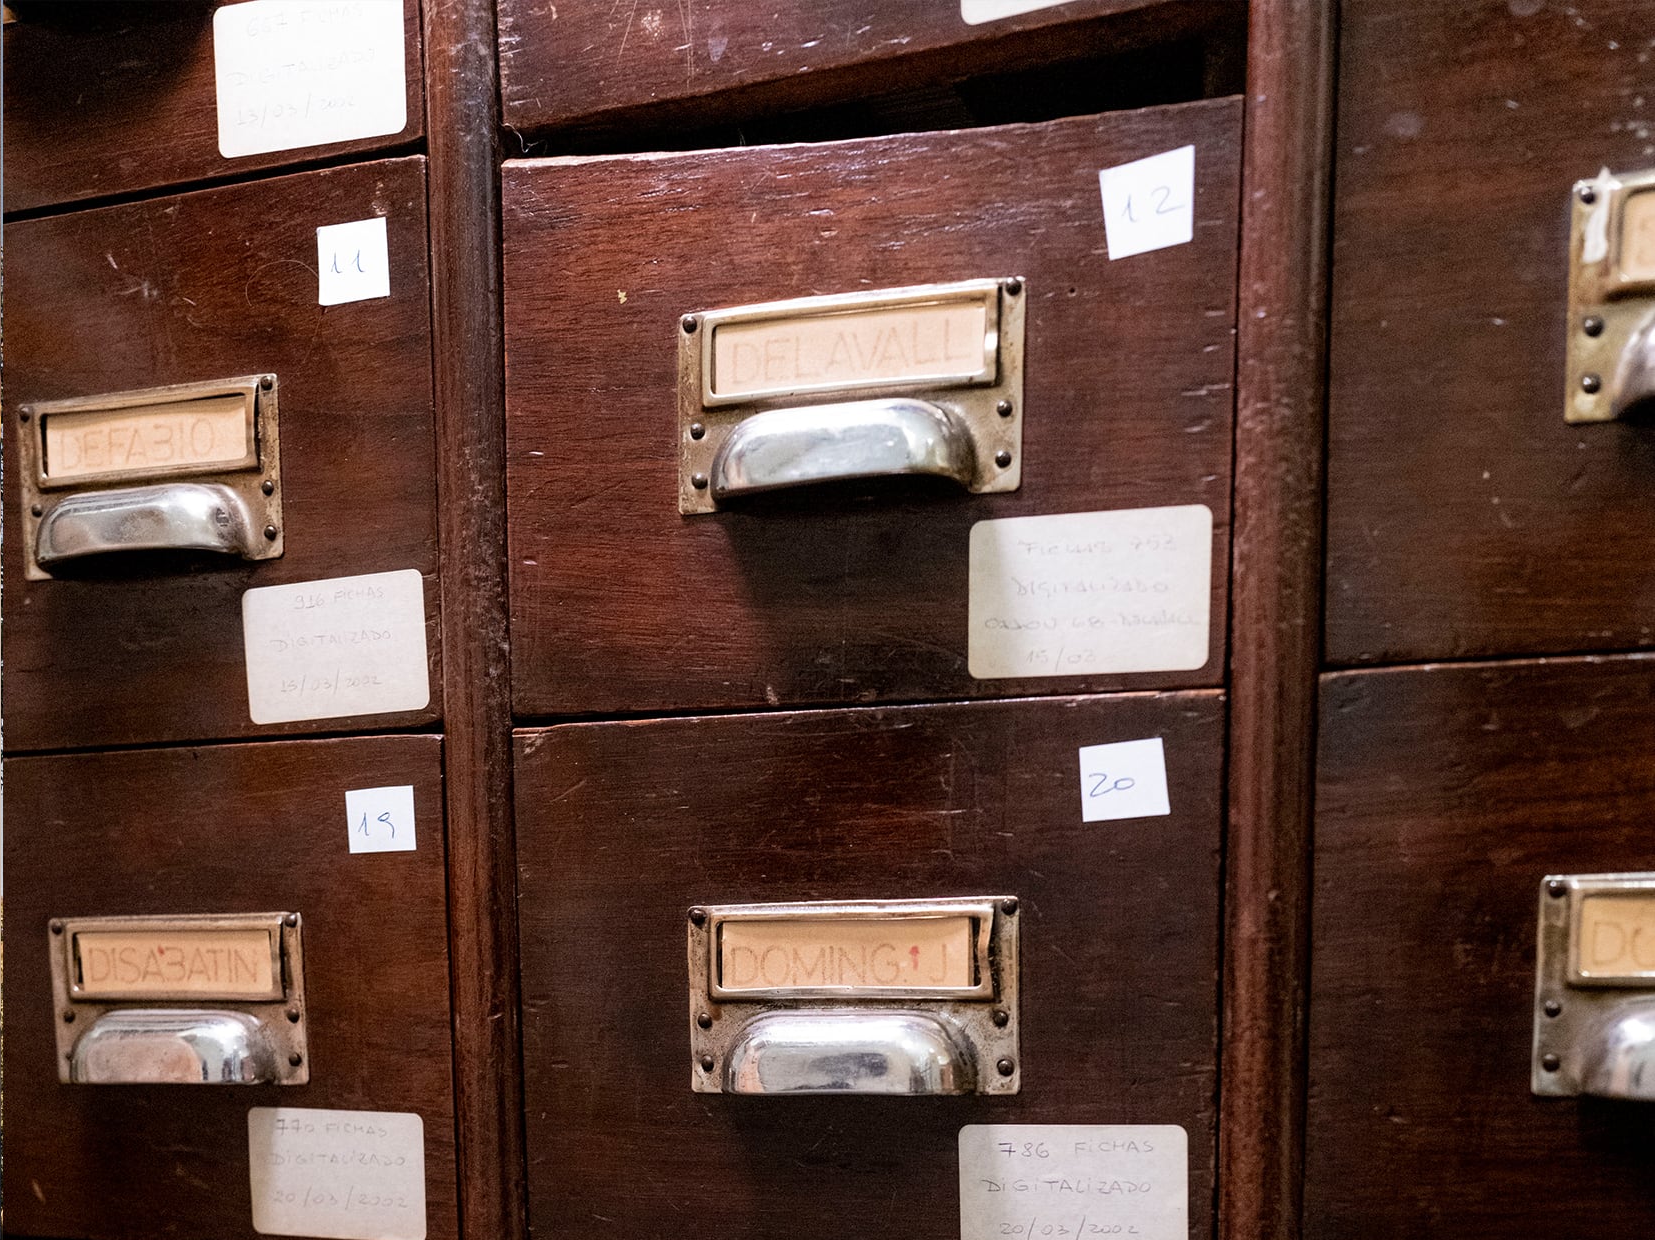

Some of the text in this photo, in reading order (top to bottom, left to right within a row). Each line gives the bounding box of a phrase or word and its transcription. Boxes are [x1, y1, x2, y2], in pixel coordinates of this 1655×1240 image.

[1120, 184, 1185, 224] 12
[730, 317, 972, 386] DELAVALL
[1088, 772, 1136, 798] 20
[357, 810, 396, 840] 19
[87, 946, 258, 985] DISABATIN
